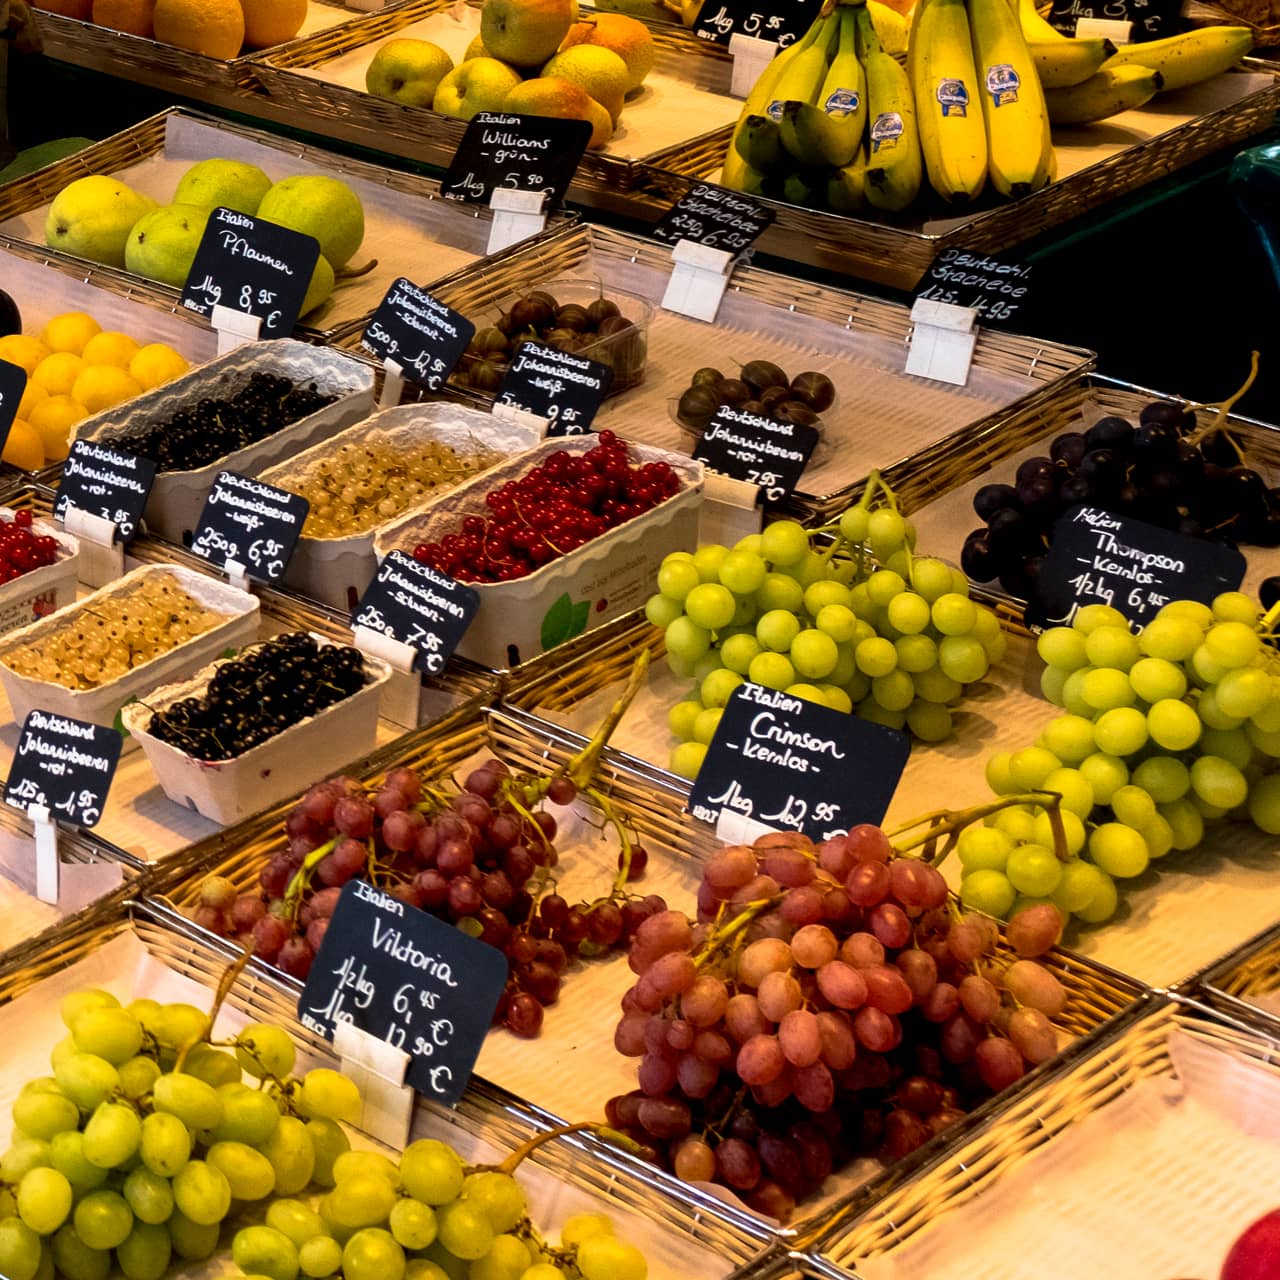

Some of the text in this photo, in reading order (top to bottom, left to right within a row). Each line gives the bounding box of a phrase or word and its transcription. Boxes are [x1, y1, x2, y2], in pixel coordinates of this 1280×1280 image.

[704, 6, 733, 34] 1kg
[481, 130, 550, 152] Williams
[451, 172, 484, 198] 1kg
[215, 208, 253, 230] Italien
[218, 230, 292, 276] Pflaumen
[191, 276, 221, 306] 1kg
[398, 279, 447, 319] Deutschland
[265, 311, 281, 329] €
[523, 342, 589, 370] Deutschland
[716, 405, 793, 436] Deutschland
[75, 441, 135, 470] Deutschland
[219, 471, 290, 504] Deutschland
[1090, 528, 1184, 574] Thompson
[389, 549, 455, 590] Deutschland
[737, 682, 802, 713] Italien
[28, 710, 95, 741] Deutschland
[748, 711, 844, 759] Crimson
[706, 781, 752, 818] 1kg
[352, 881, 403, 917] Italien
[370, 918, 457, 988] Viktoria
[429, 1019, 453, 1047] €
